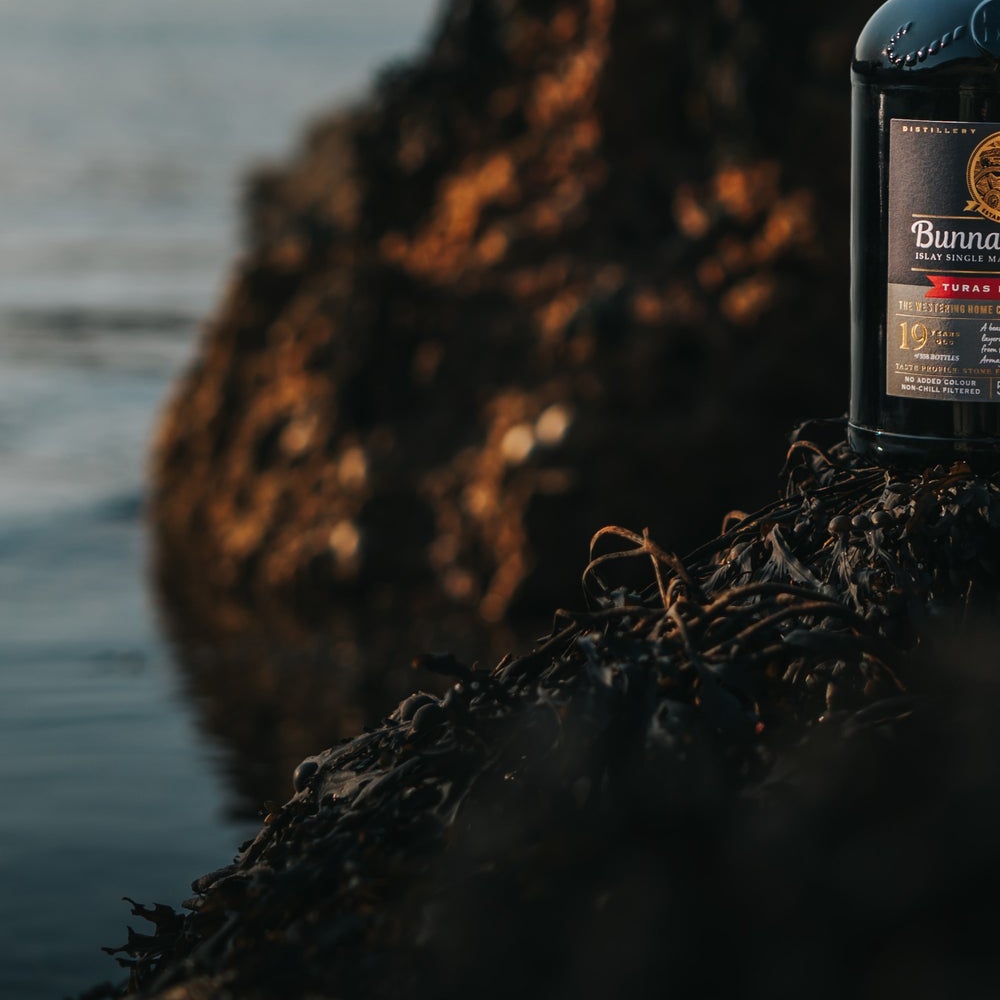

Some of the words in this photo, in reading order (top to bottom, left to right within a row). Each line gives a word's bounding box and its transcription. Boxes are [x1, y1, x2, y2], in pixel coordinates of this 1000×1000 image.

[902, 125, 977, 135] DISTILLERY
[915, 252, 943, 261] ISLAY
[946, 253, 984, 263] SINGLE
[942, 283, 991, 293] TURAS
[899, 301, 913, 311] THE
[915, 302, 965, 314] WESTERING
[968, 305, 993, 314] HOME
[980, 323, 987, 332] A
[899, 321, 928, 351] 19
[981, 344, 998, 354] from
[930, 353, 960, 362] BOTTLES
[895, 363, 919, 372] TASTE
[963, 367, 992, 375] STONE
[917, 377, 941, 385] ADDED
[901, 383, 940, 393] NON-CHILL
[942, 387, 981, 395] FILTERED
